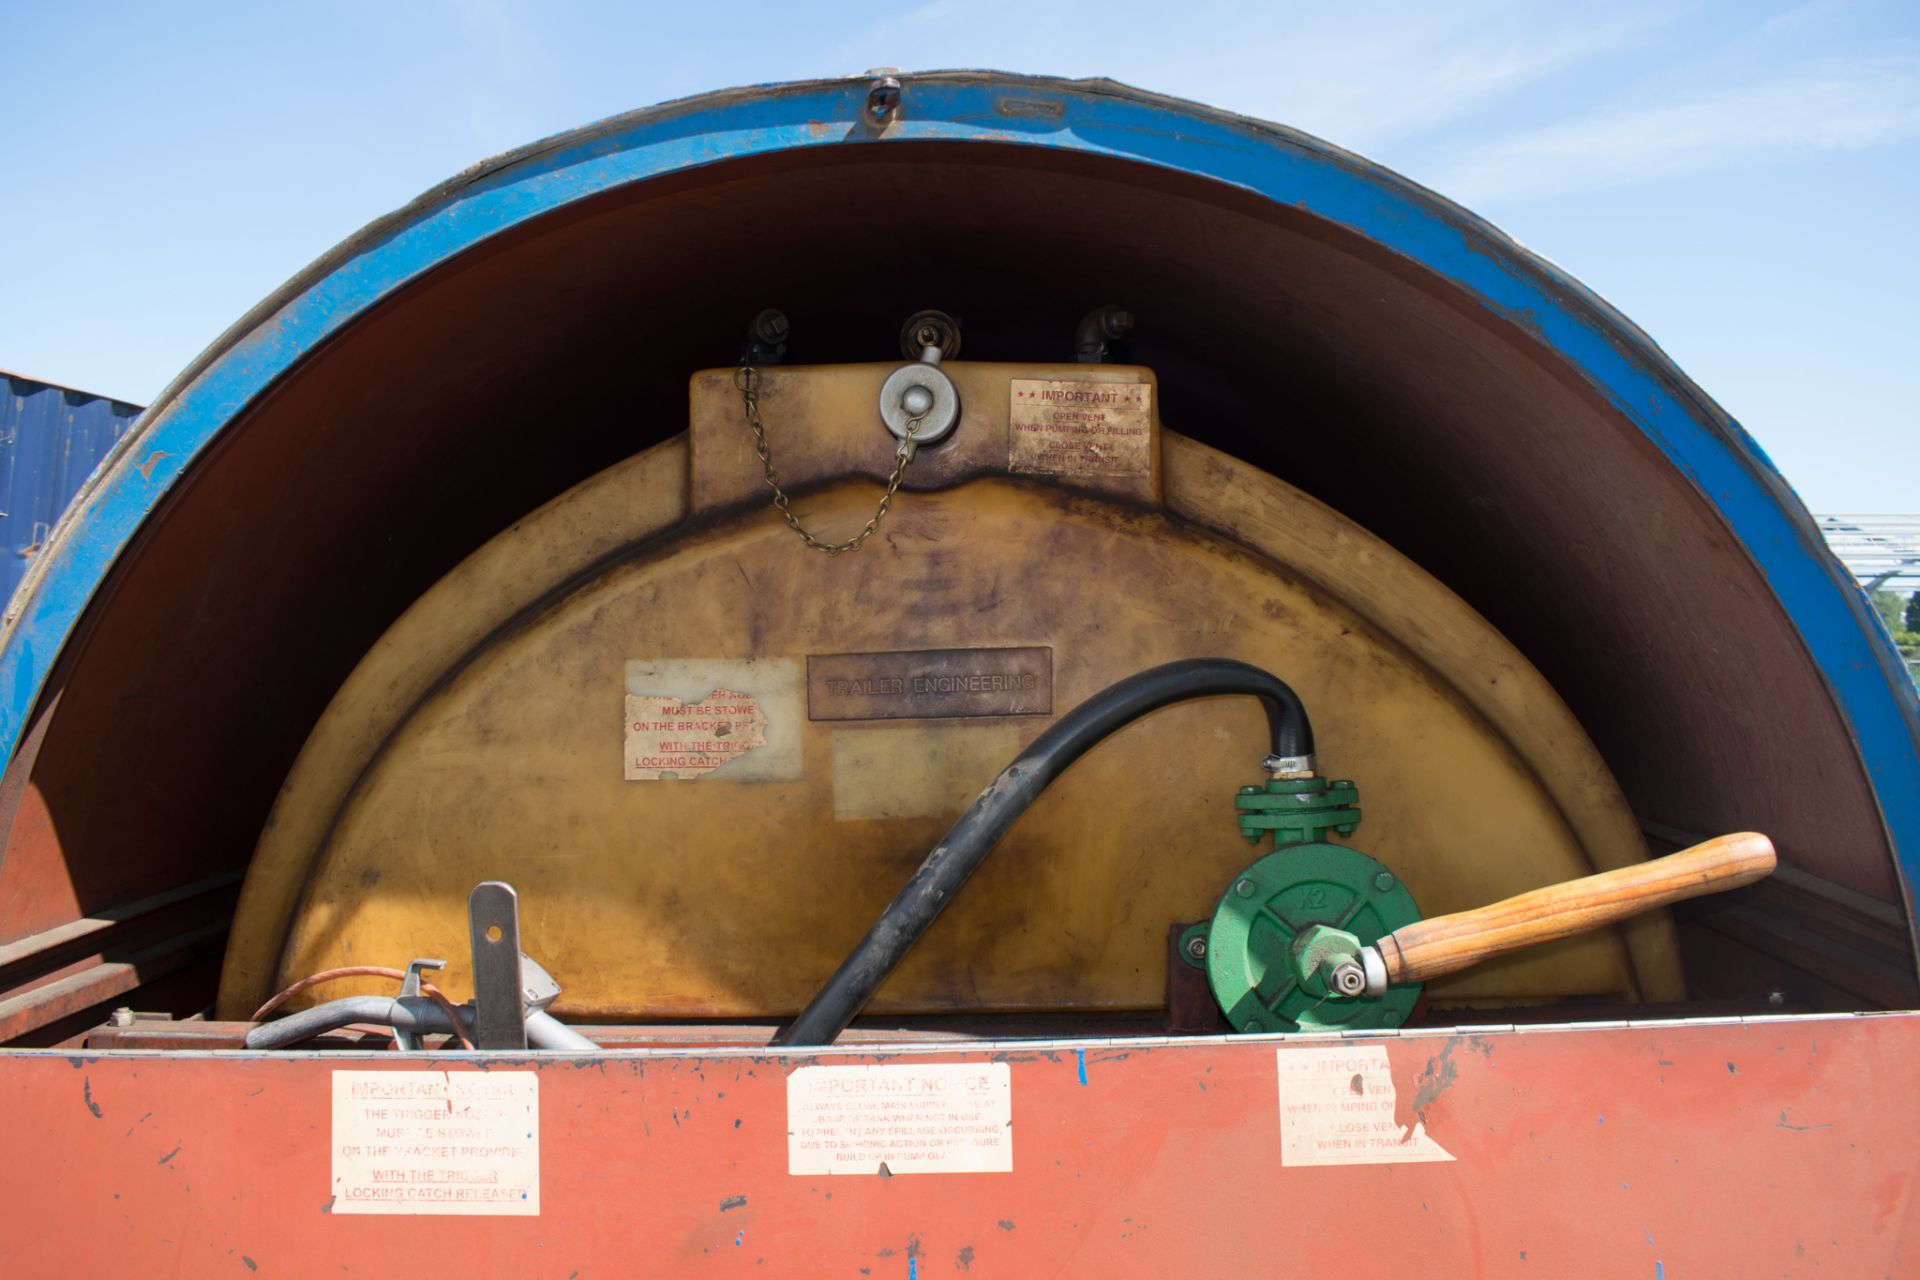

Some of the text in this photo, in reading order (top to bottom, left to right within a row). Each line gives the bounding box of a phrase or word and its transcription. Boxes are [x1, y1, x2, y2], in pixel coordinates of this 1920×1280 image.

[1041, 390, 1118, 403] IMPORTANT
[1053, 412, 1106, 421] OPEN VENT
[1015, 424, 1143, 436] WHEN PUMPING OR FILLING
[826, 675, 1036, 696] TRAILER ENGINEERING
[662, 705, 755, 715] MUST BE STOWE
[633, 722, 649, 731] ON
[652, 722, 674, 731] THE
[659, 741, 688, 751] WITH
[692, 741, 712, 751] THE
[635, 757, 686, 766] LOCKING
[1299, 888, 1327, 910] K2
[351, 1082, 448, 1096] IMPORTAN
[1368, 1085, 1391, 1095] VEN
[1325, 1101, 1377, 1113] PMPING
[364, 1109, 388, 1120] THE
[1330, 1122, 1396, 1132] LOSE VEN
[376, 1128, 410, 1139] MUS
[1317, 1139, 1352, 1150] WHEN
[1355, 1139, 1366, 1148] IN
[461, 1147, 520, 1157] PROVIDE
[372, 1169, 405, 1181] WITH
[410, 1170, 434, 1181] THE
[345, 1188, 404, 1199] LOCKING
[408, 1188, 452, 1199] CATCH
